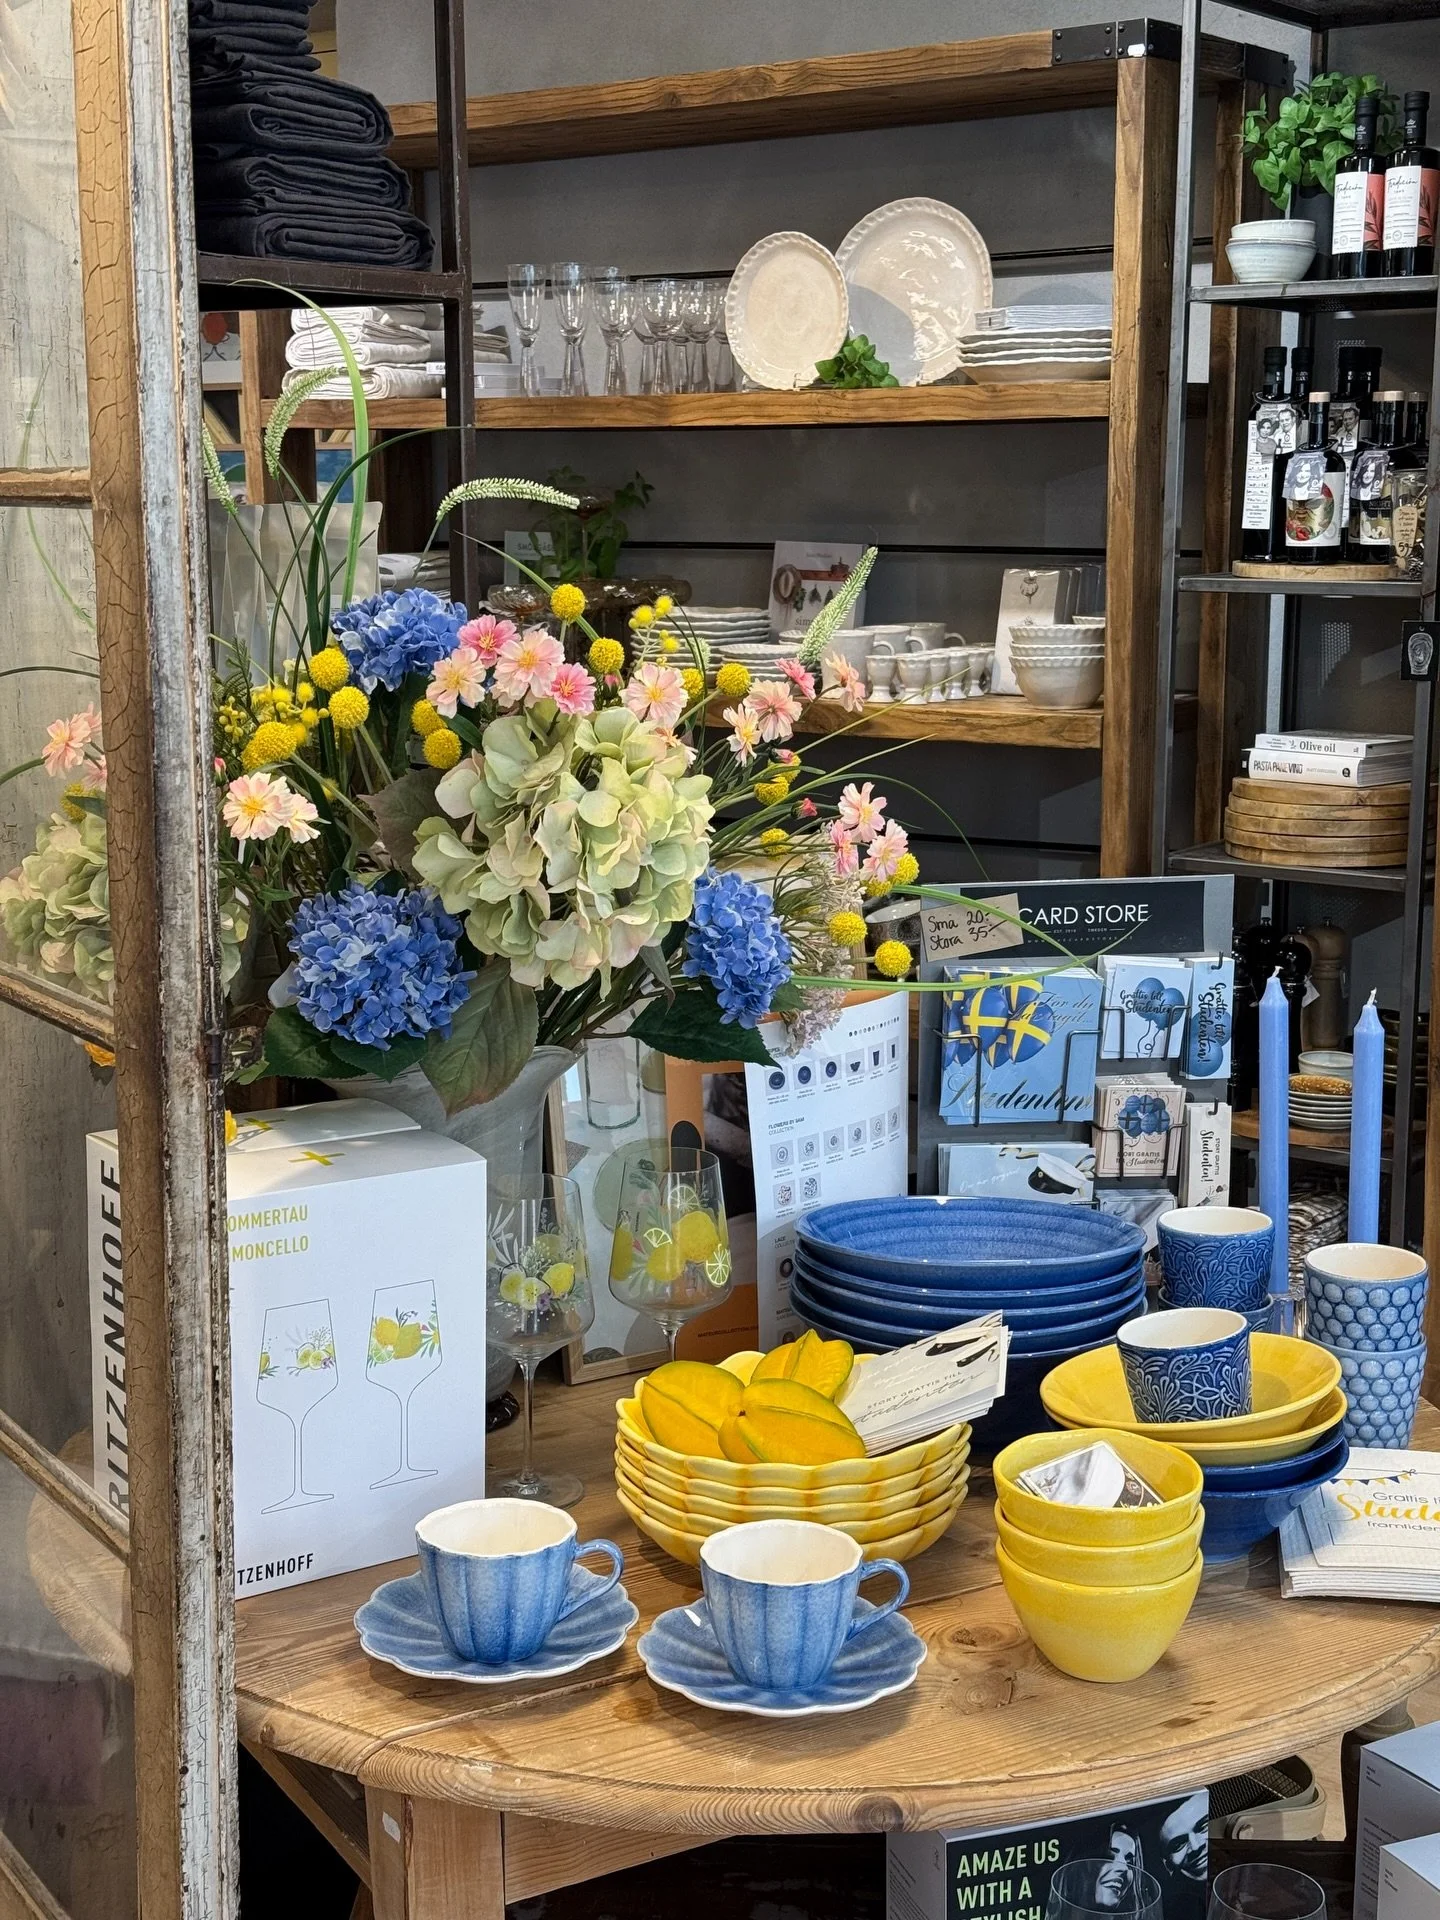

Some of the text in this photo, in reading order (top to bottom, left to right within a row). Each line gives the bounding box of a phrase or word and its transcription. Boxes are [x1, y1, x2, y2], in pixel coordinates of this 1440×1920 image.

[1299, 740, 1322, 752] Olive
[1324, 743, 1336, 753] oil
[1253, 760, 1272, 772] PASTA
[1084, 903, 1149, 924] STORE
[929, 934, 964, 951] Stora
[1120, 989, 1148, 1005] Grattis
[1209, 982, 1228, 1020] Grattis
[1197, 991, 1217, 1063] Studenten!
[1199, 1129, 1214, 1183] Studenten!
[228, 1204, 308, 1233] OMMERTAU
[232, 1235, 309, 1262] MONCELLO
[100, 1159, 130, 1521] RITZENHOFF
[867, 1393, 898, 1410] STORT
[900, 1379, 941, 1397] GRATTIS
[1322, 1492, 1440, 1522] Stude
[1372, 1491, 1430, 1504] Grattis
[237, 1552, 314, 1586] TZENHOFF
[956, 1844, 1028, 1879] AMAZE
[1034, 1838, 1060, 1866] US
[956, 1876, 1033, 1911] WITH A
